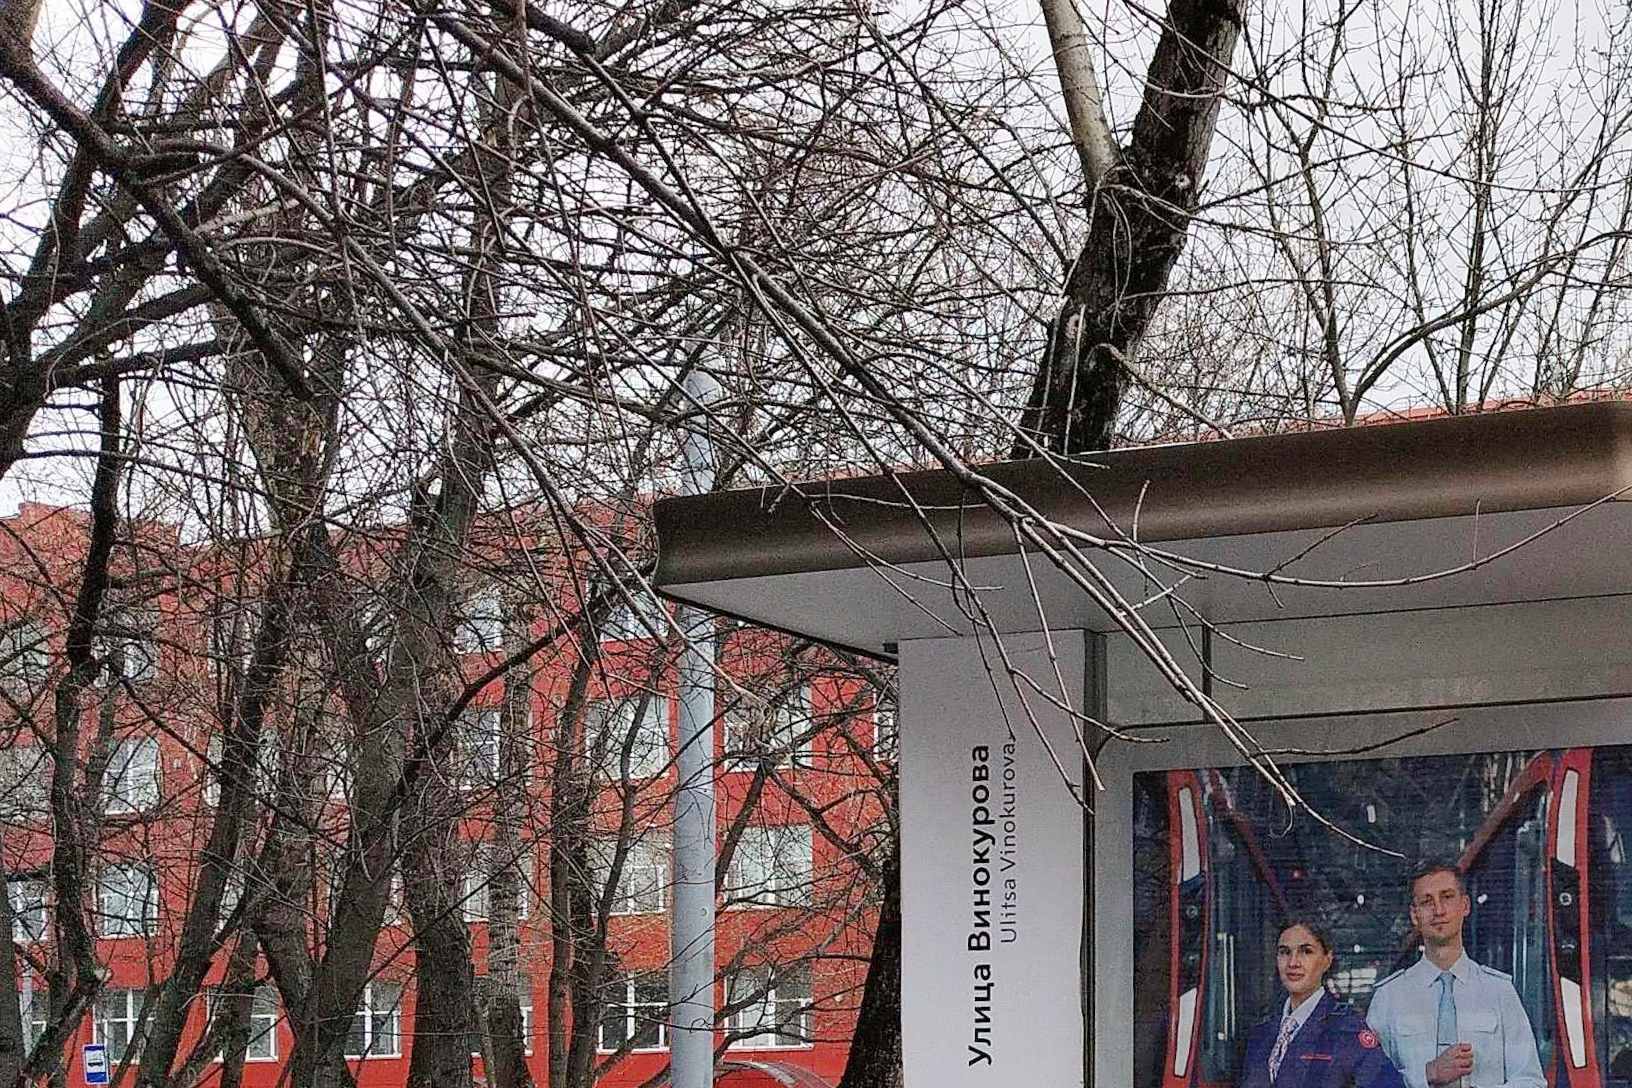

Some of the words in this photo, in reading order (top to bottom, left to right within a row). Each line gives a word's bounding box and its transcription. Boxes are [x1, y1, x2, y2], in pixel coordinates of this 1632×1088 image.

[967, 744, 997, 952] Винокурова
[999, 741, 1017, 873] Vinokurova
[1000, 875, 1017, 944] Ulitsa
[967, 964, 993, 1067] Улица
